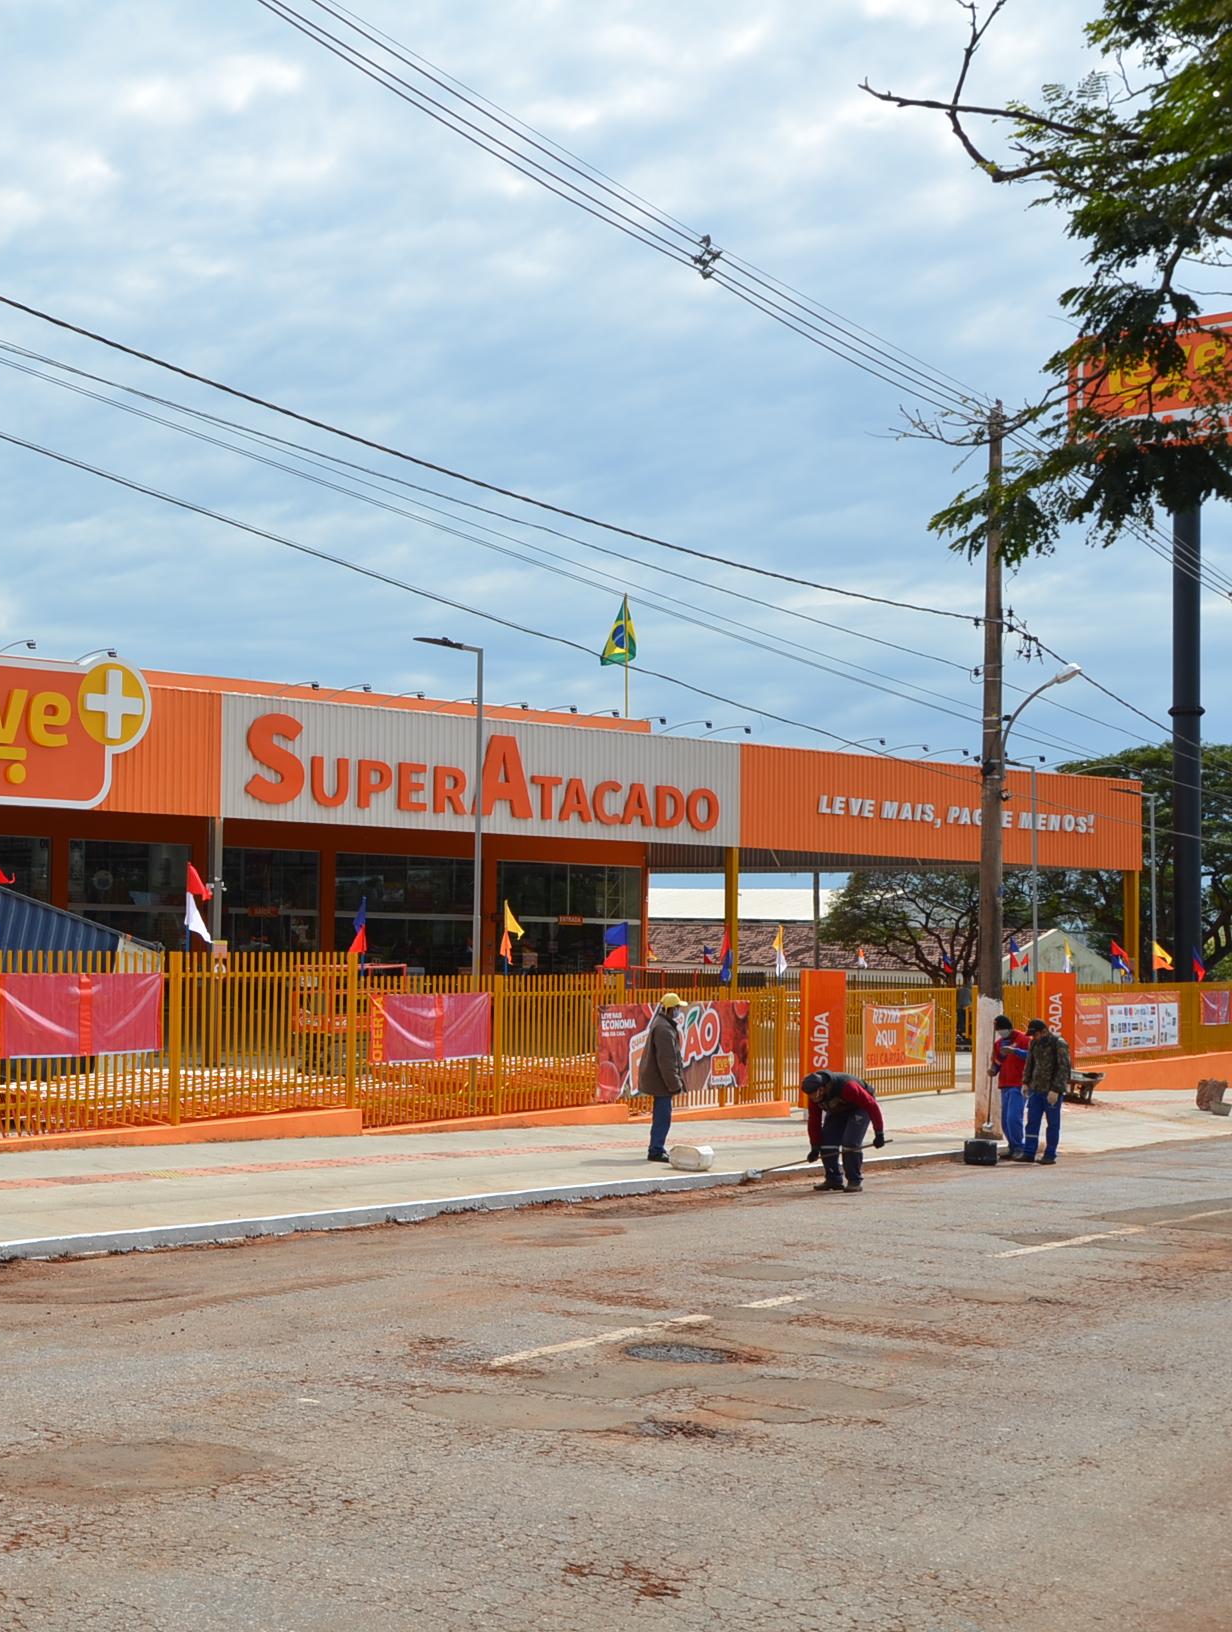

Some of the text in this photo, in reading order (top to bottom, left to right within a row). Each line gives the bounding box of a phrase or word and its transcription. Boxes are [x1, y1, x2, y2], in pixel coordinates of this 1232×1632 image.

[818, 795, 1095, 834] LEVE MAIS, PAGE MENOS!
[372, 996, 384, 1061] OFERTA
[601, 1018, 636, 1030] ECONOMIA
[810, 1011, 830, 1068] SAÍDA
[875, 1030, 896, 1049] AQUI
